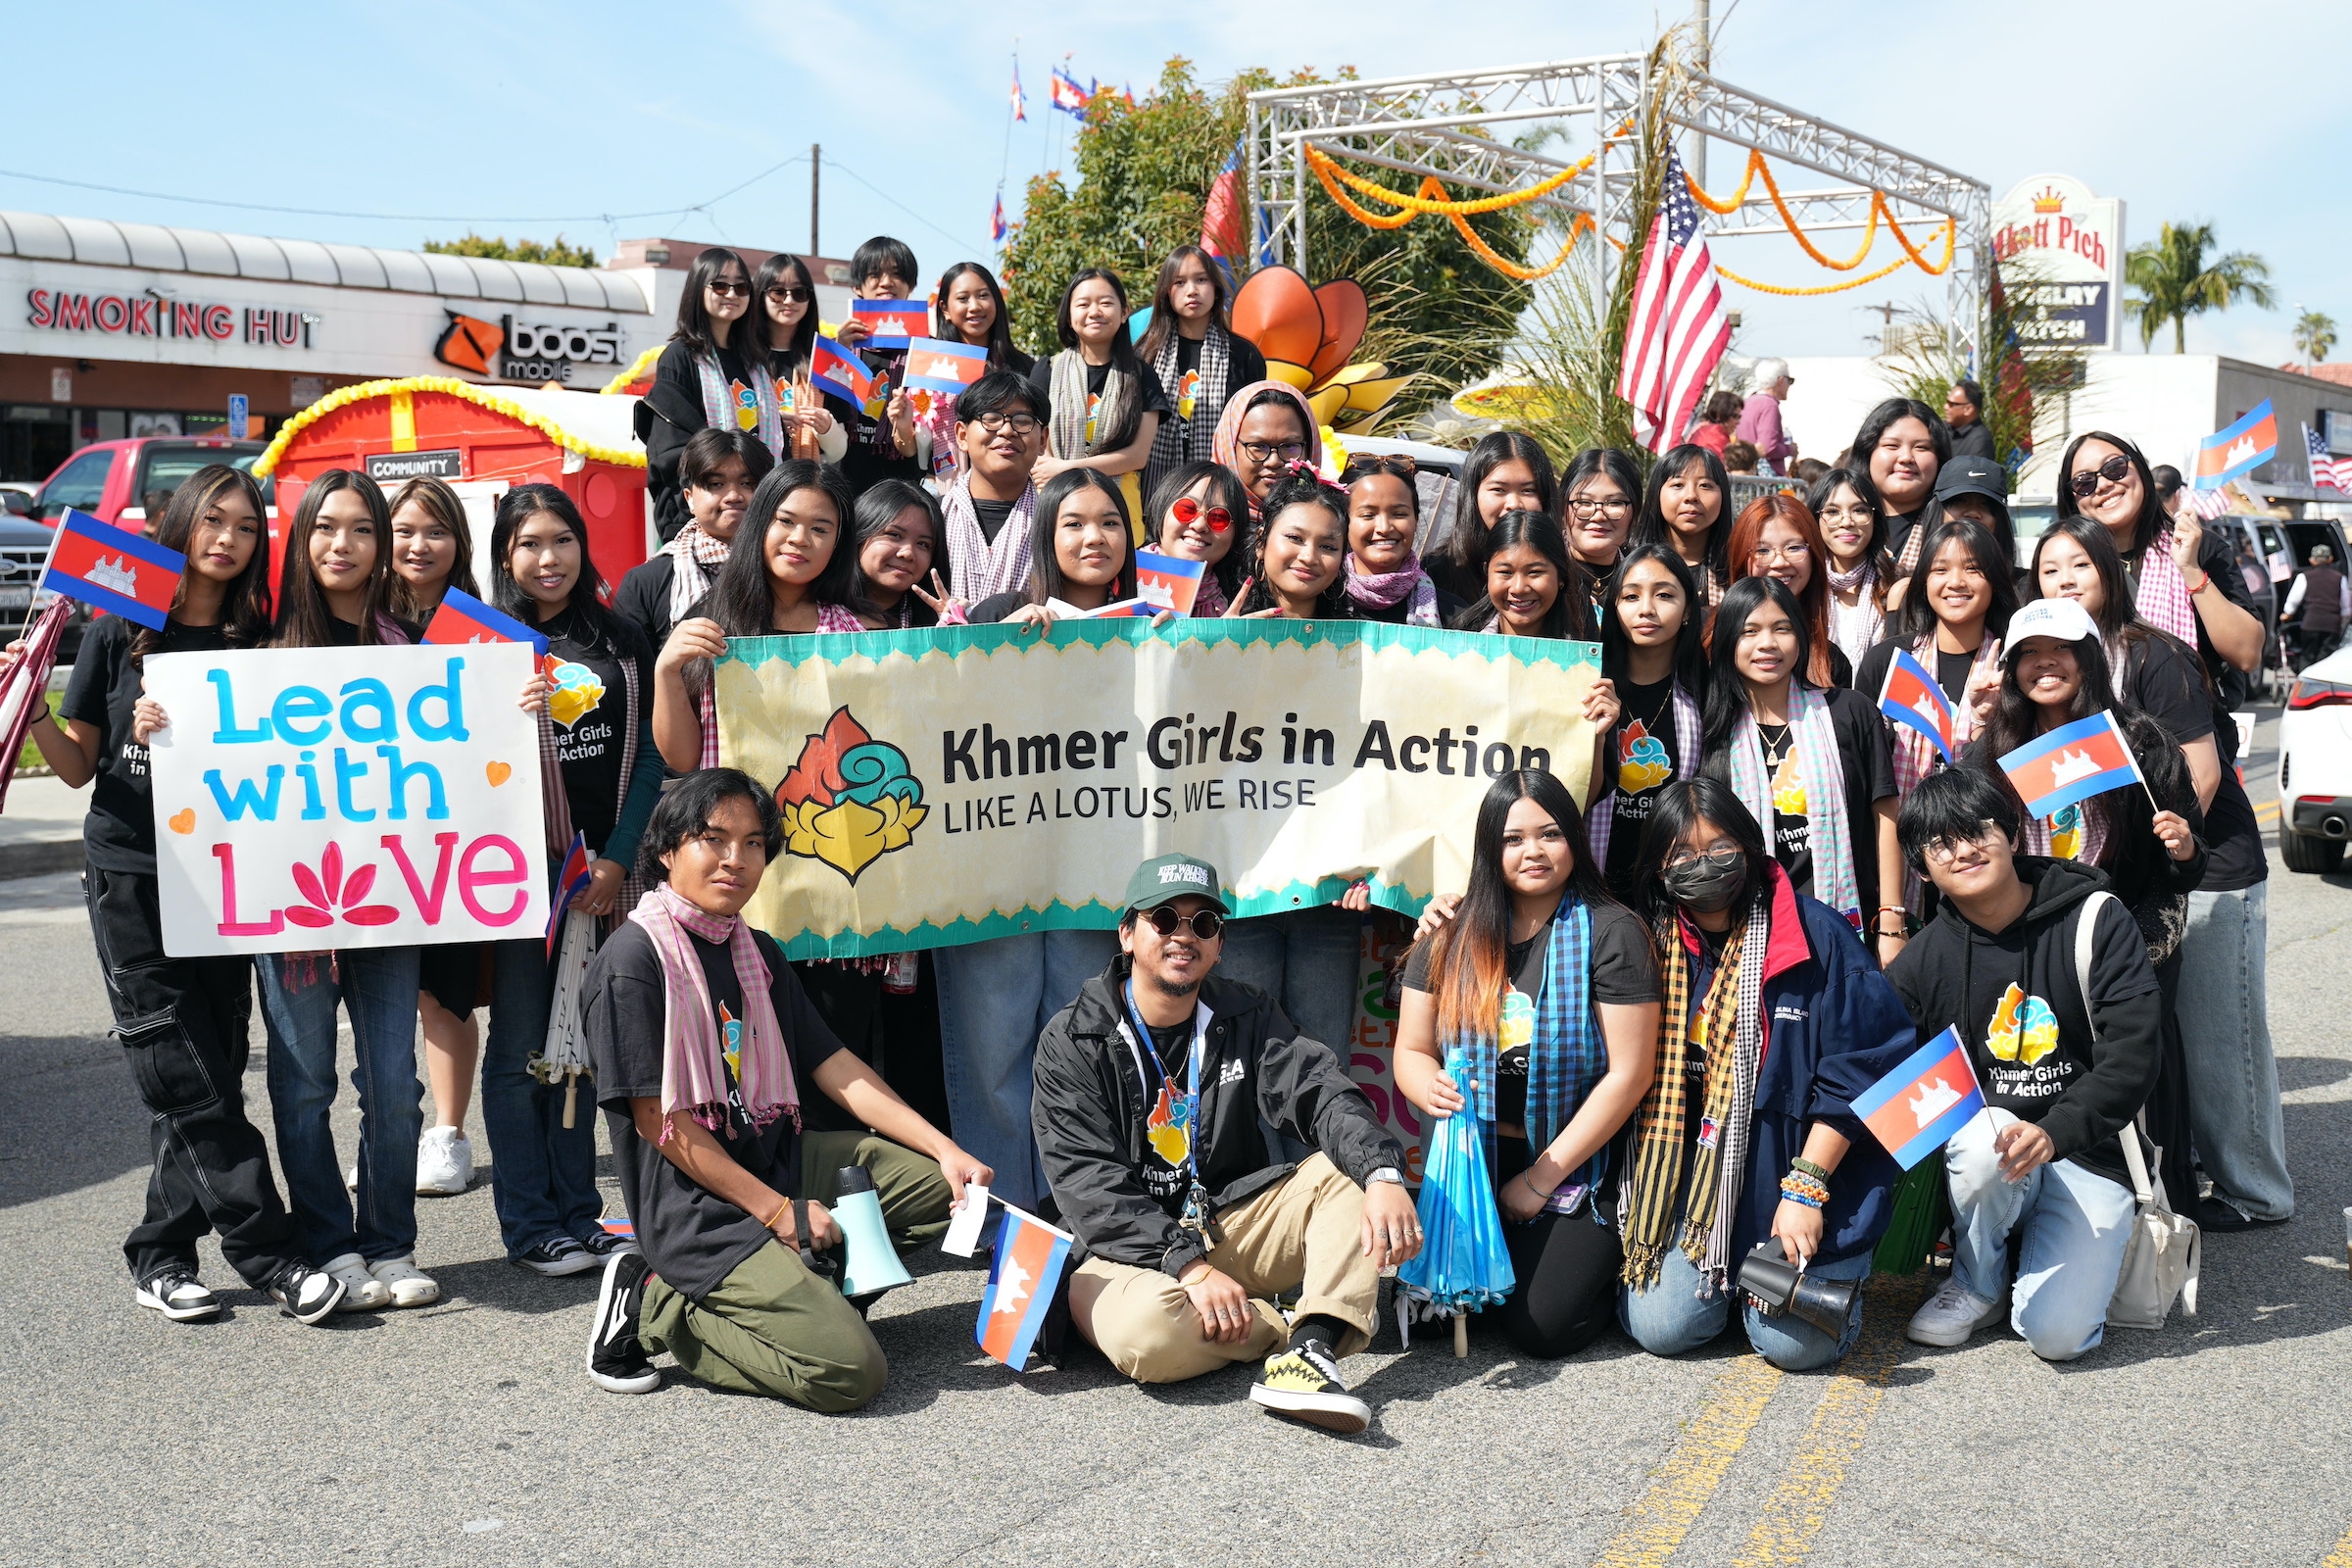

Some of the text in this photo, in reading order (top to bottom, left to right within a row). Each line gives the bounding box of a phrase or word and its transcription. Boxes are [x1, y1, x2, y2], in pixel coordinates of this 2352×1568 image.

[2057, 215, 2105, 270] Pich
[29, 288, 320, 349] SMOKING HUT
[507, 316, 630, 366] boost
[506, 361, 572, 382] mobile
[372, 459, 448, 477] COMMUNITY
[207, 657, 469, 746] Lead
[579, 723, 612, 742] Girls
[559, 743, 605, 762] Action
[943, 710, 1551, 784] Khmer Girls in Action
[130, 760, 146, 776] in
[203, 745, 450, 822] with
[945, 778, 1316, 834] LIKE A LOTUS, WE RISE
[1788, 841, 1803, 853] in
[1157, 864, 1178, 877] KEEP
[1988, 1061, 2073, 1082] Khmer Girls
[1996, 1081, 2062, 1098] in Action
[1142, 1164, 1183, 1183] Khmer
[1149, 1182, 1164, 1197] in
